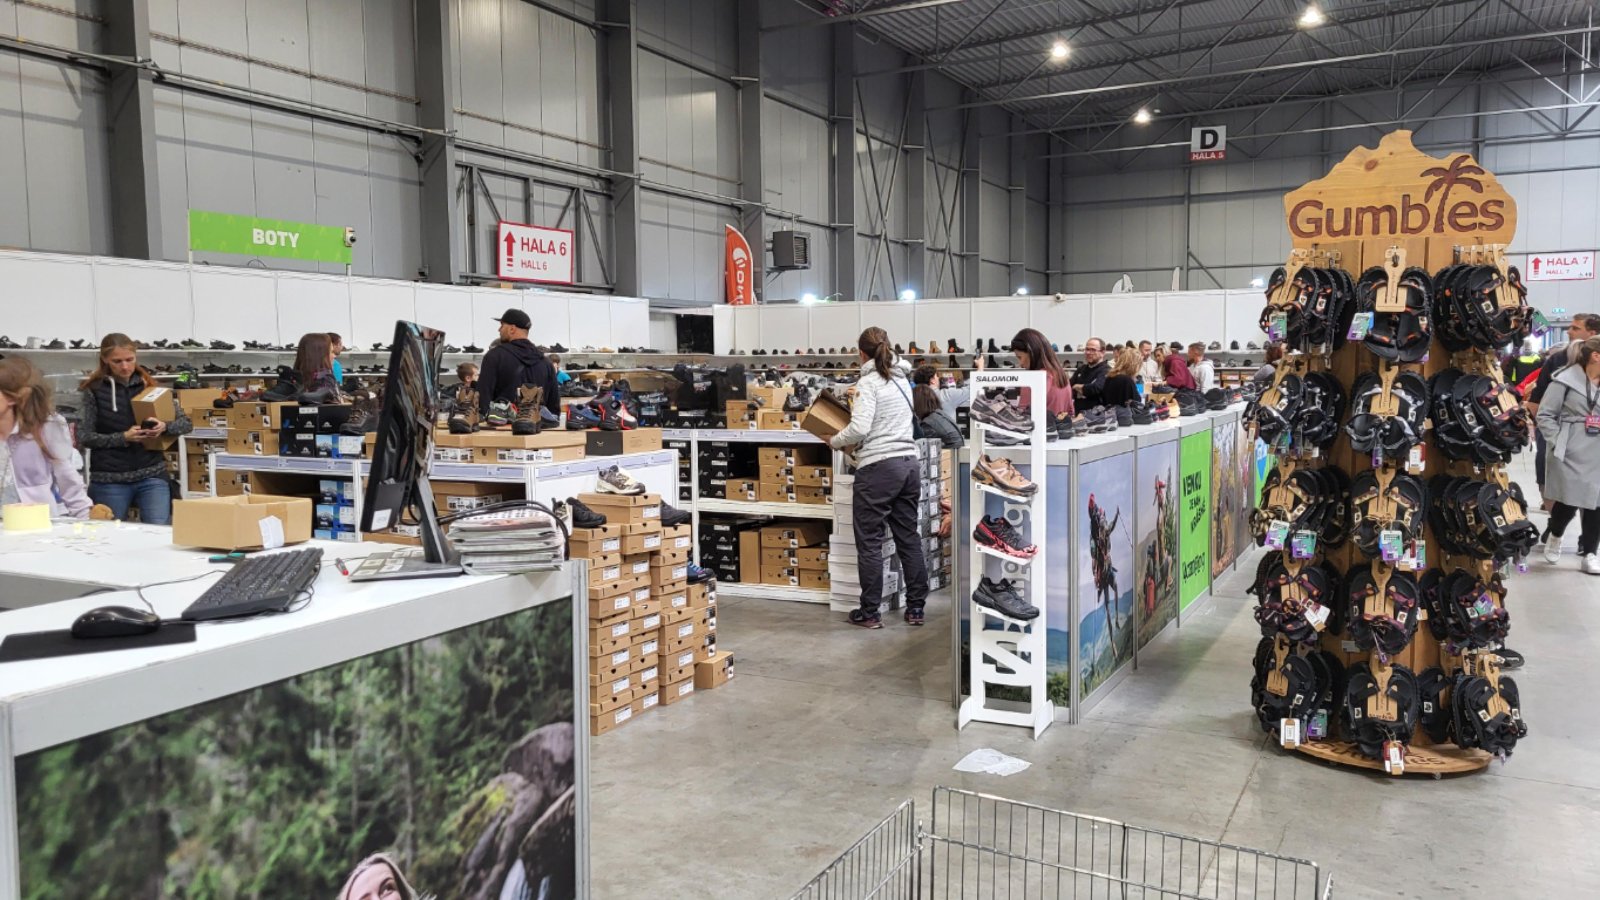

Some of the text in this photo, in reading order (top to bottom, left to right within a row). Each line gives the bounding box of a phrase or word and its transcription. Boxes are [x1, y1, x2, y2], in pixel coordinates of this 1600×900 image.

[1200, 129, 1219, 150] D
[1192, 152, 1216, 160] HALA
[1288, 178, 1505, 239] Gumbies
[253, 228, 300, 248] BOTY
[521, 236, 567, 257] HALA 6
[521, 259, 548, 271] HALL 6
[1546, 256, 1589, 266] HALA 7
[975, 375, 1019, 383] SALOMON
